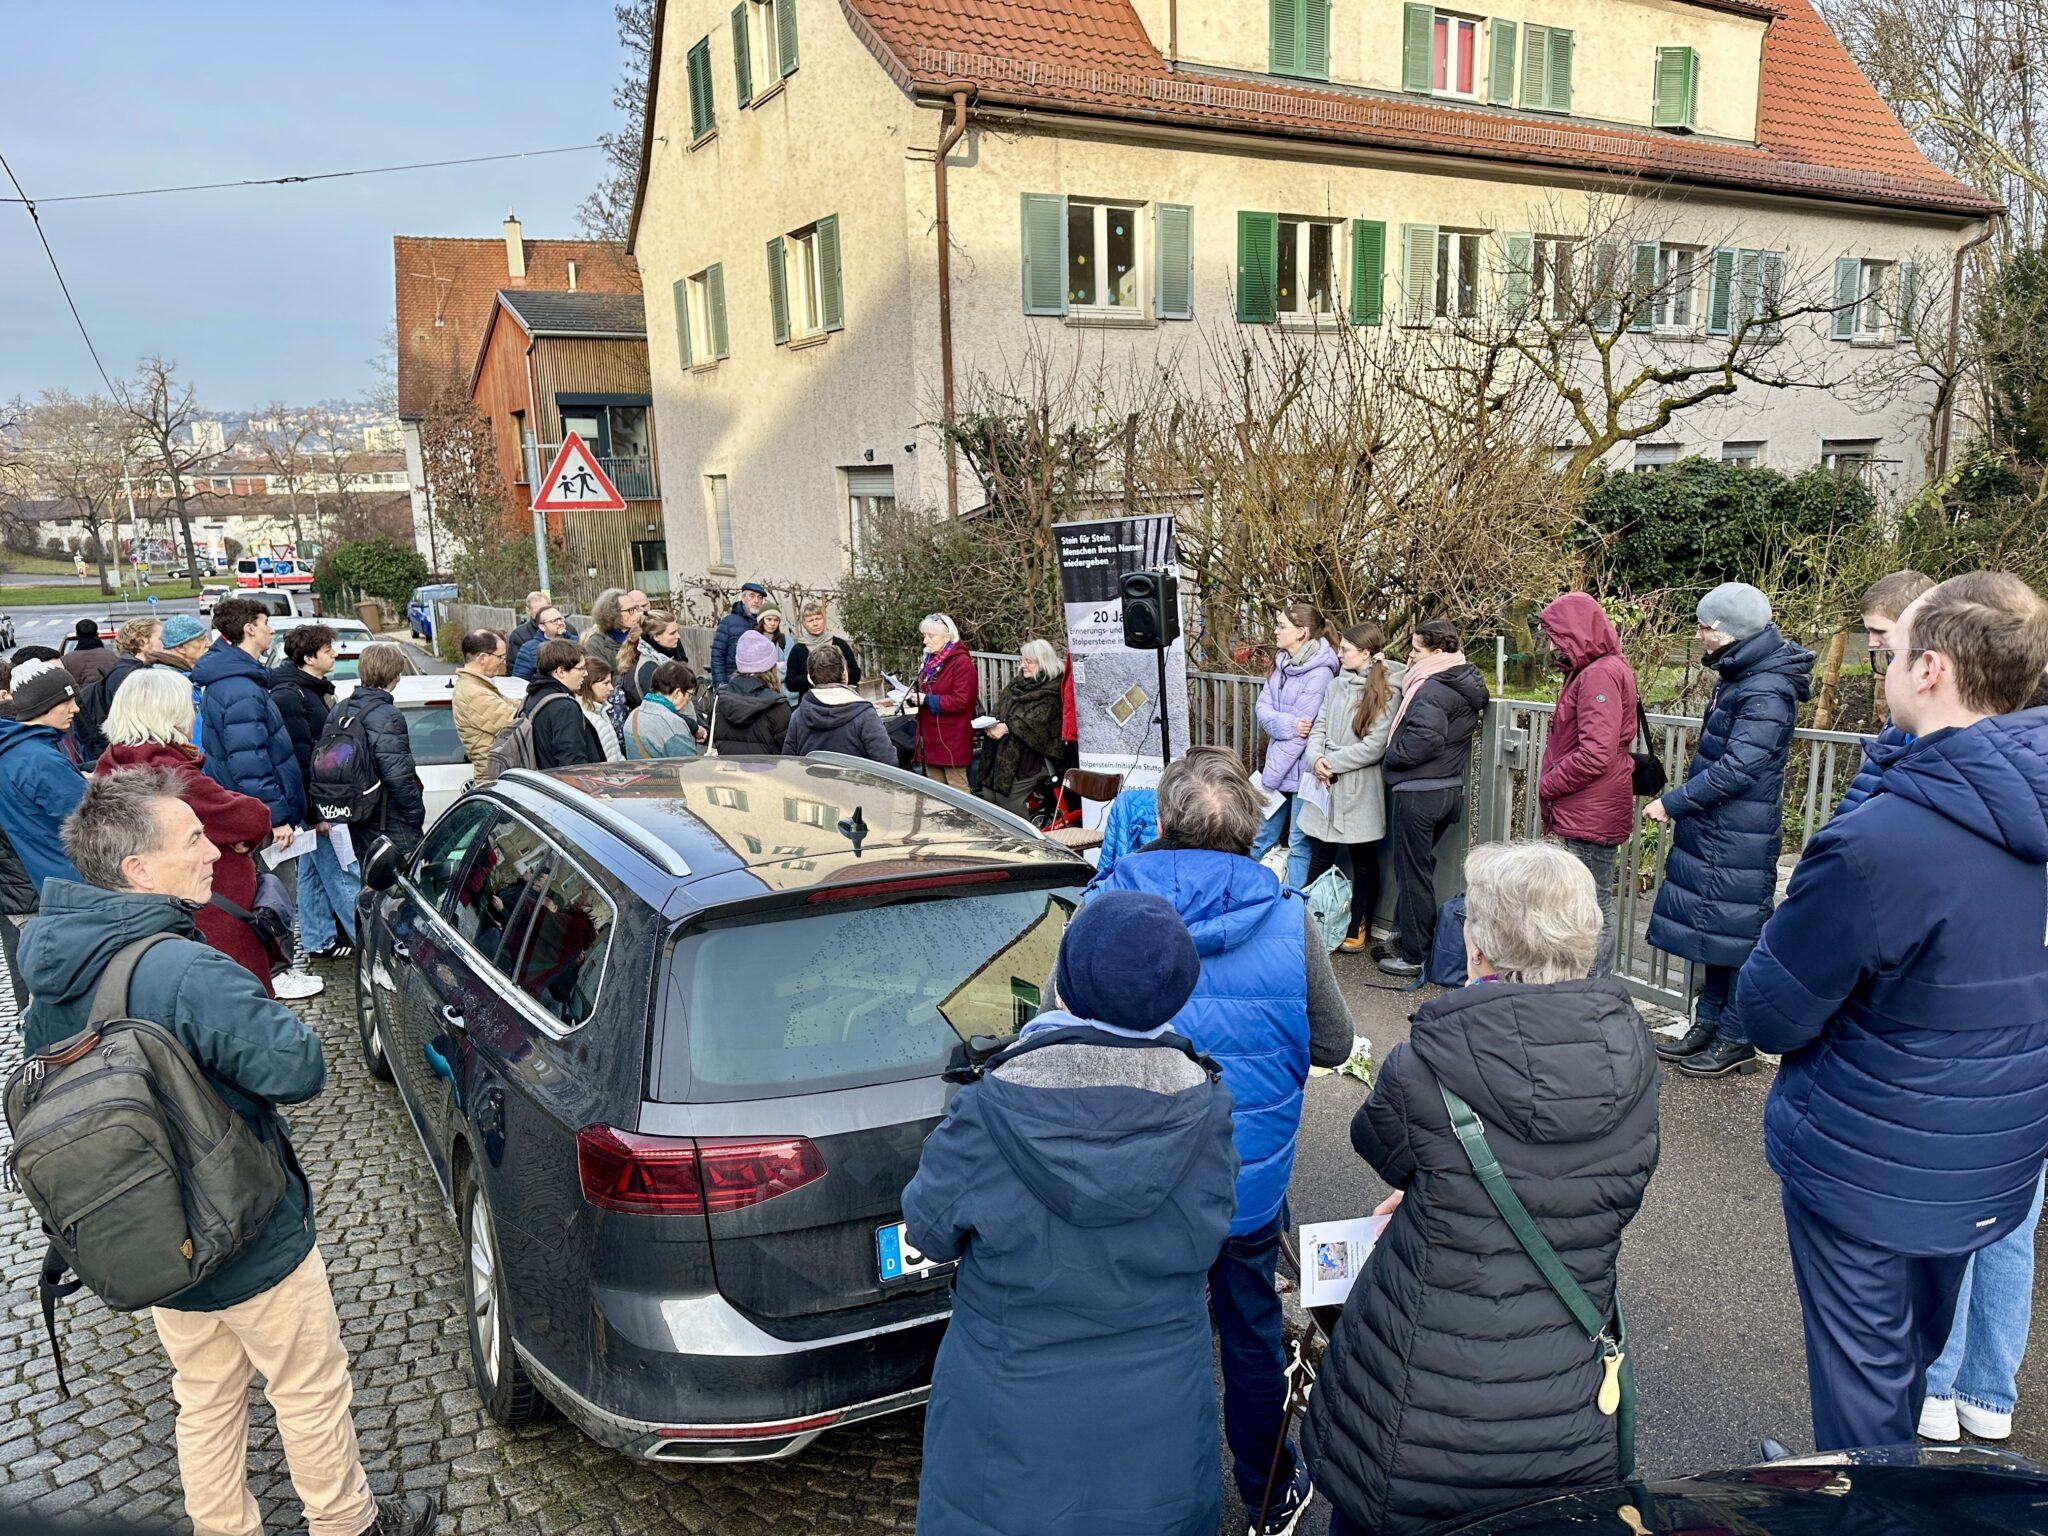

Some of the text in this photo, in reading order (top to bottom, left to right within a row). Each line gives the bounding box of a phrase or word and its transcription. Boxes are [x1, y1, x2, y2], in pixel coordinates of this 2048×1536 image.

[1061, 533, 1111, 545] Stein für Stein
[1062, 546, 1097, 556] Menschen
[1118, 543, 1144, 552] Namen
[1063, 557, 1109, 568] wiedergeben
[1093, 611, 1108, 623] 20
[1072, 638, 1115, 647] Stolpersteine
[886, 1258, 896, 1271] D
